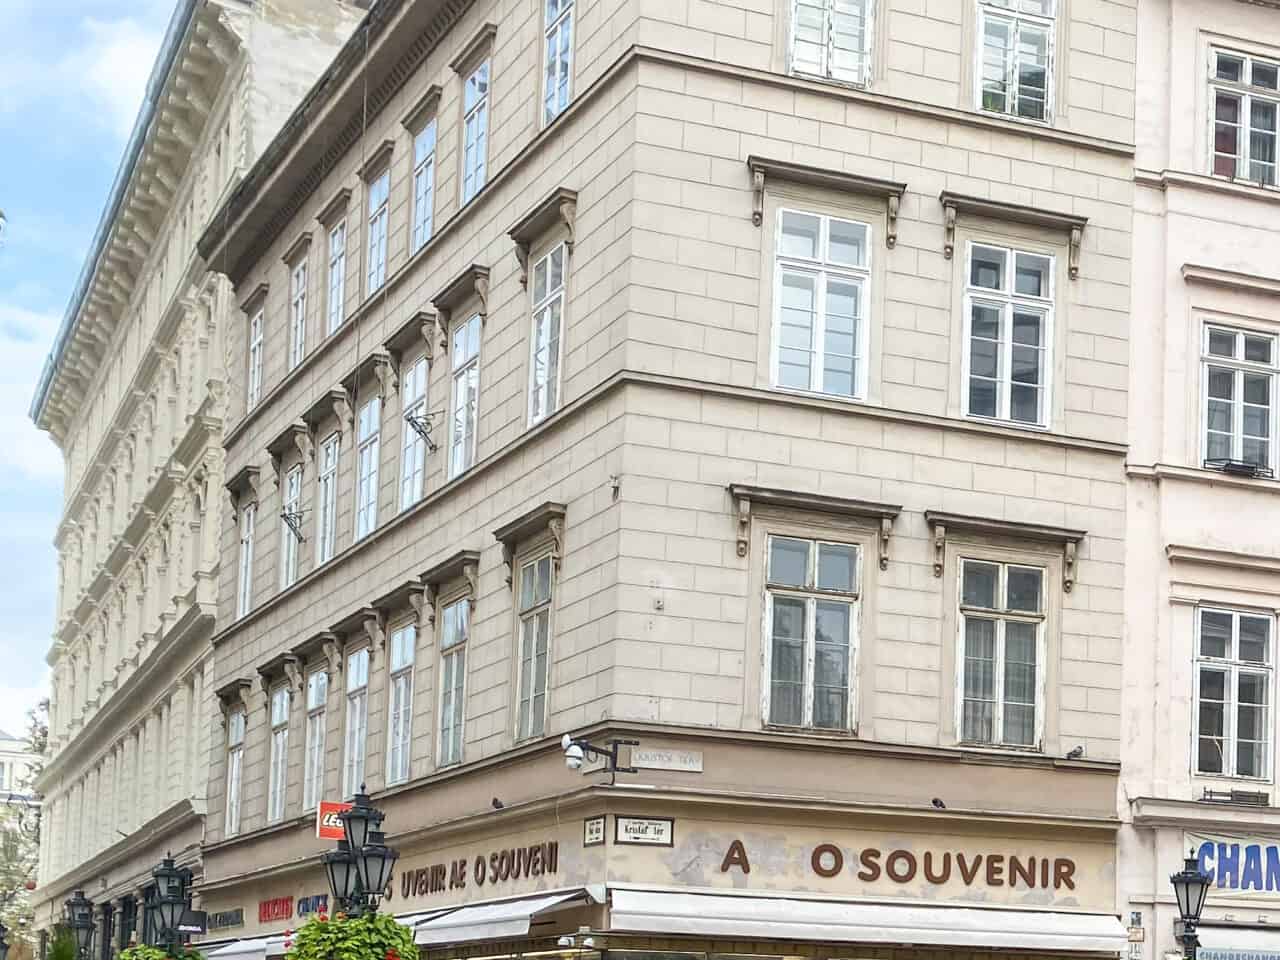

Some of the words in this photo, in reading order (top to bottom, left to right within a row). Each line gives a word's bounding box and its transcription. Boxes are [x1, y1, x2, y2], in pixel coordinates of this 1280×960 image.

[721, 840, 750, 874] A
[811, 844, 843, 878] O
[857, 848, 1076, 890] SOUVENIR
